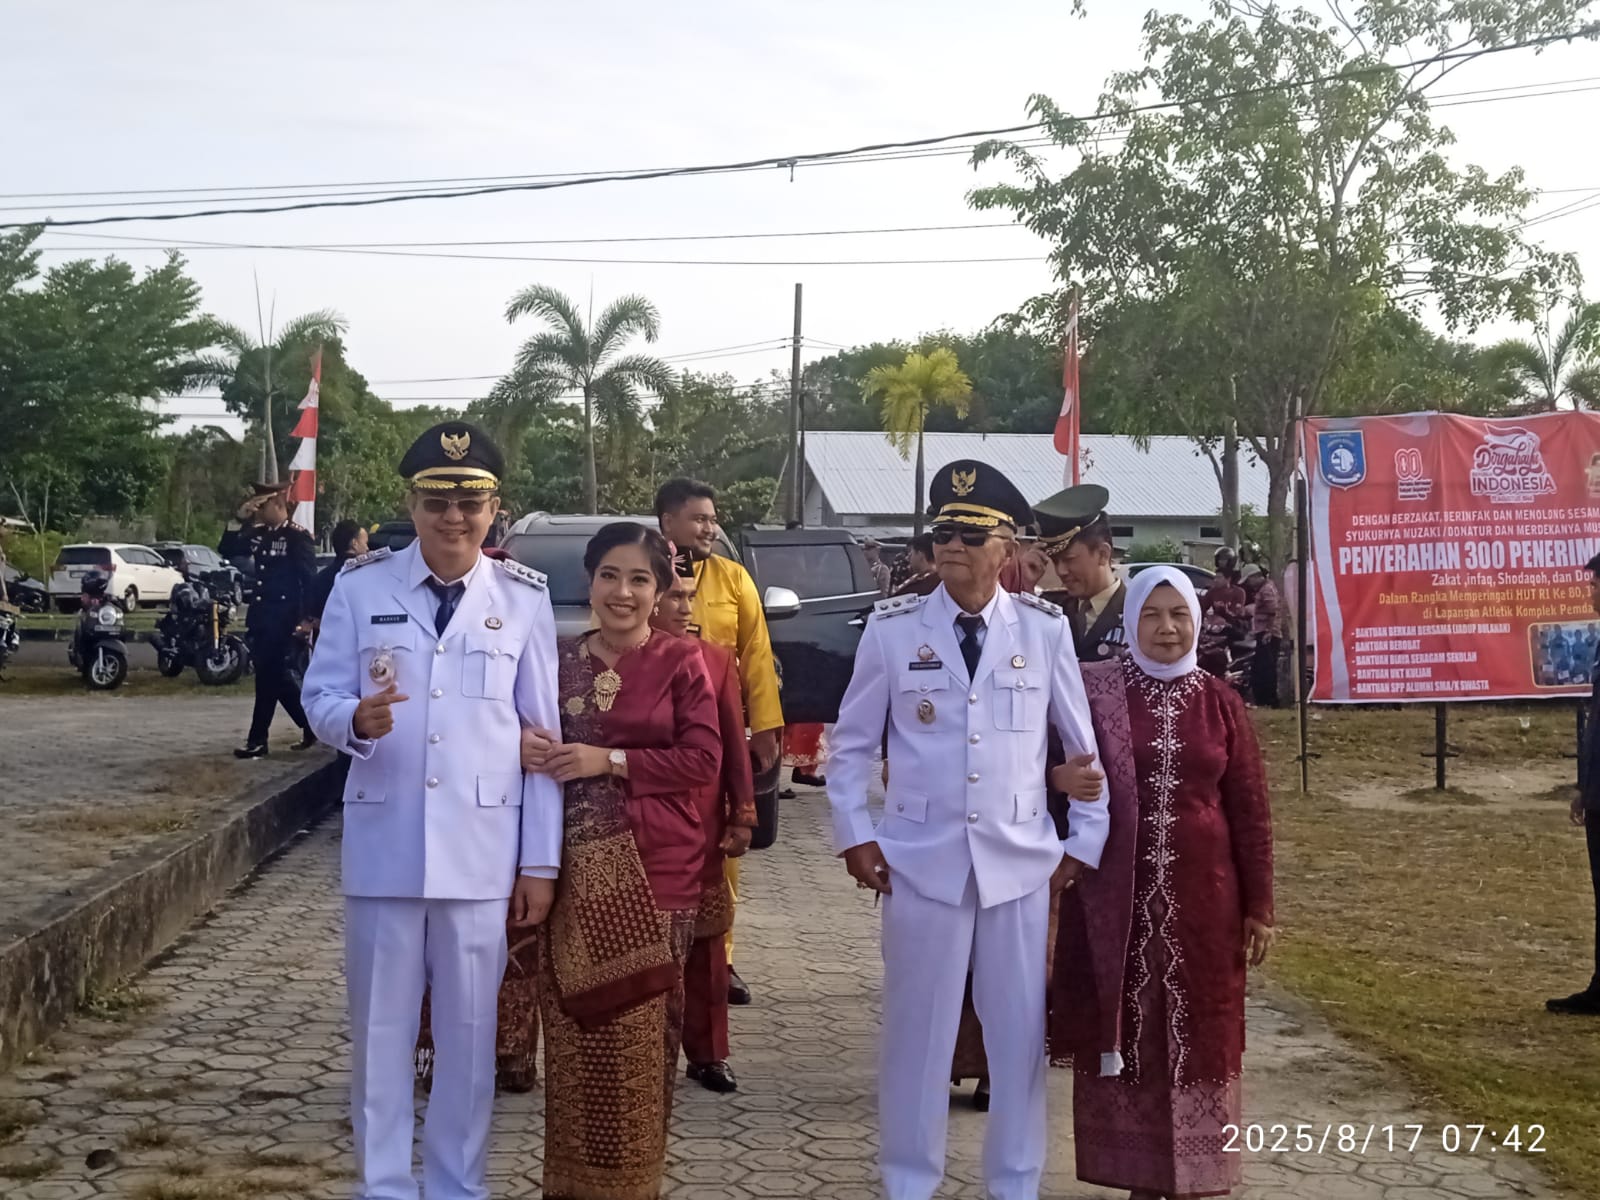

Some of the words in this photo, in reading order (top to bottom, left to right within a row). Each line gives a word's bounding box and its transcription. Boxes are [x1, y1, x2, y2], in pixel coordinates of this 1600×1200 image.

[1476, 441, 1543, 476] Dirgahayu
[1472, 477, 1554, 491] INDONESIA
[1352, 514, 1390, 526] DENGAN
[1443, 510, 1491, 522] BERINFAK
[1493, 509, 1512, 521] DAN
[1515, 508, 1565, 520] MENOLONG
[1567, 507, 1600, 519] SESAM
[1345, 528, 1400, 541] SYUKURNYA
[1403, 526, 1440, 539] MUZAKI
[1495, 524, 1514, 536] DAN
[1517, 523, 1580, 535] MERDEKANYA
[1339, 542, 1460, 575] PENYERAHAN
[1464, 540, 1505, 570] 300
[1431, 572, 1461, 586] Zakat
[1497, 571, 1551, 587] Shodaqoh,
[1552, 570, 1572, 583] dan
[1379, 592, 1408, 604] Dalam
[1411, 590, 1448, 604] Rangka
[1449, 588, 1513, 603] Memperingati
[1516, 588, 1537, 600] HUT
[1552, 586, 1566, 599] Ke
[1423, 607, 1432, 619] di
[1434, 607, 1480, 620] Lapangan
[1482, 605, 1513, 617] Atletik
[1515, 603, 1556, 619] Komplek
[1560, 602, 1594, 616] Pemda
